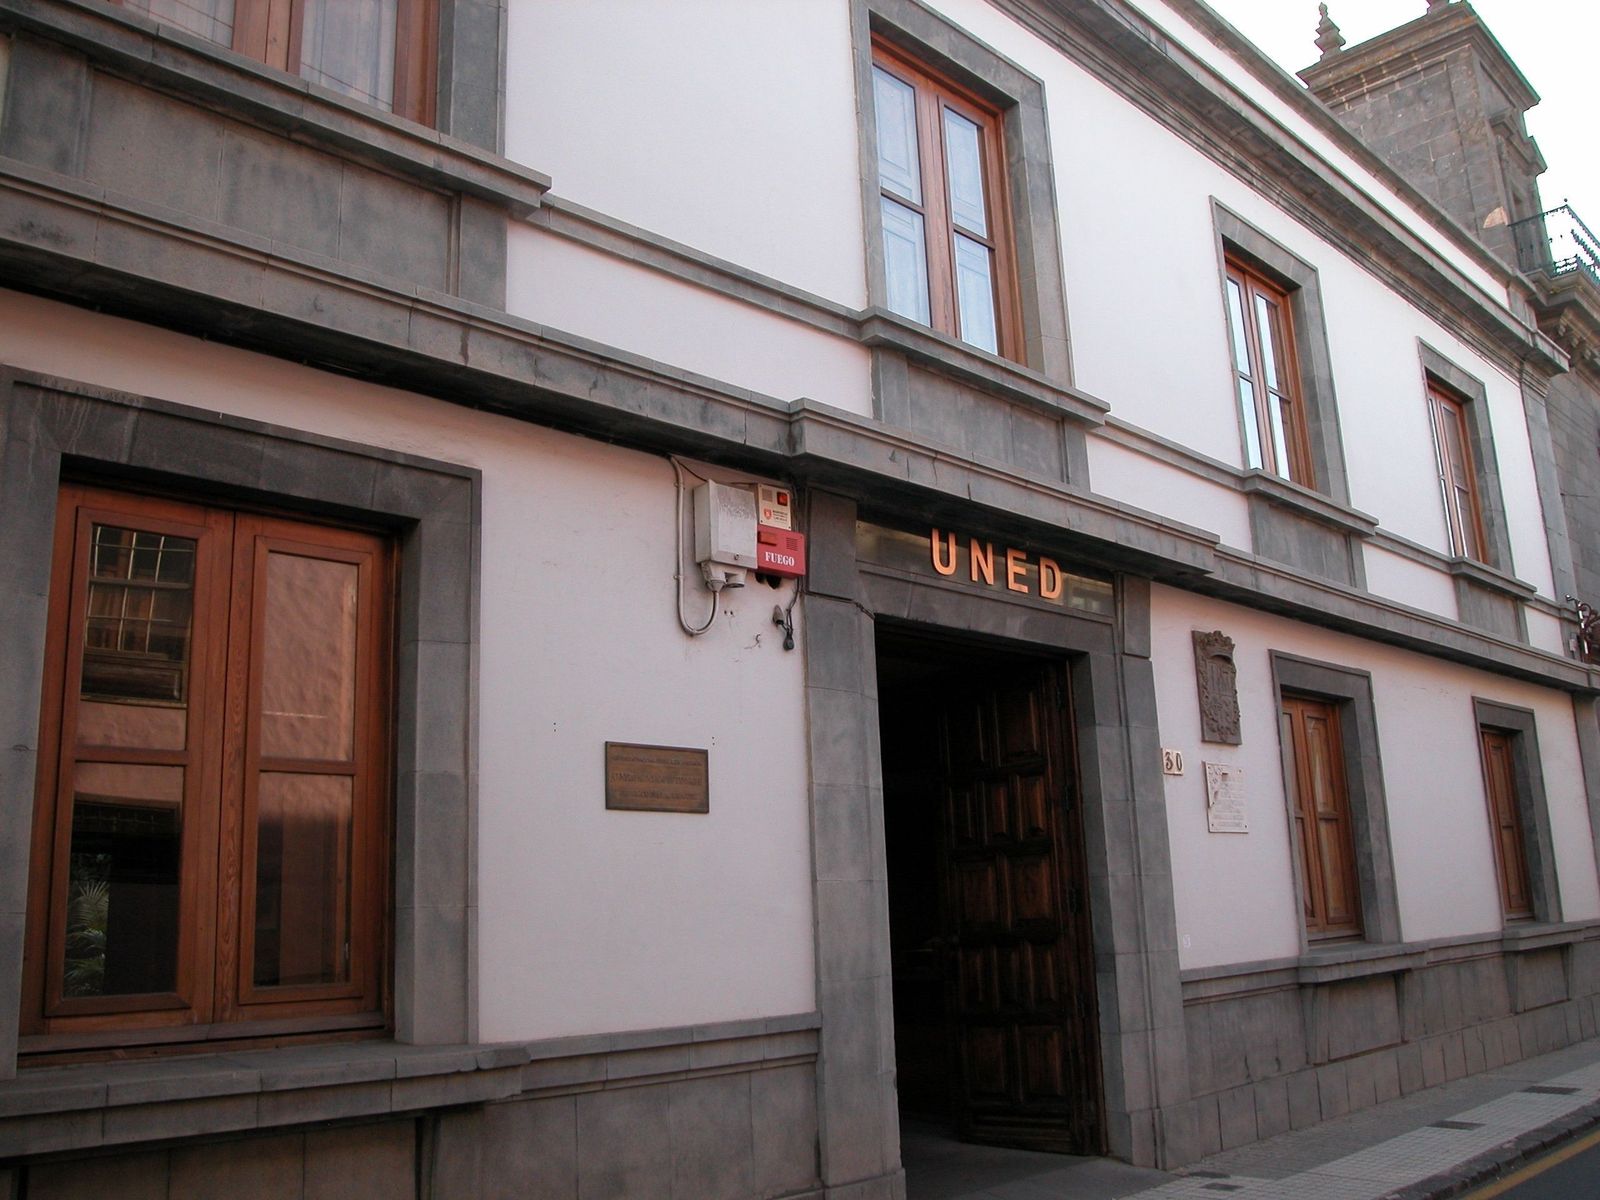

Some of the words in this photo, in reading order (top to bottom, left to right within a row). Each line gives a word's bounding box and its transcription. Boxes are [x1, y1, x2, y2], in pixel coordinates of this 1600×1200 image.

[765, 551, 795, 566] FUEGO
[931, 527, 1063, 599] UNED
[1165, 752, 1182, 771] 30
